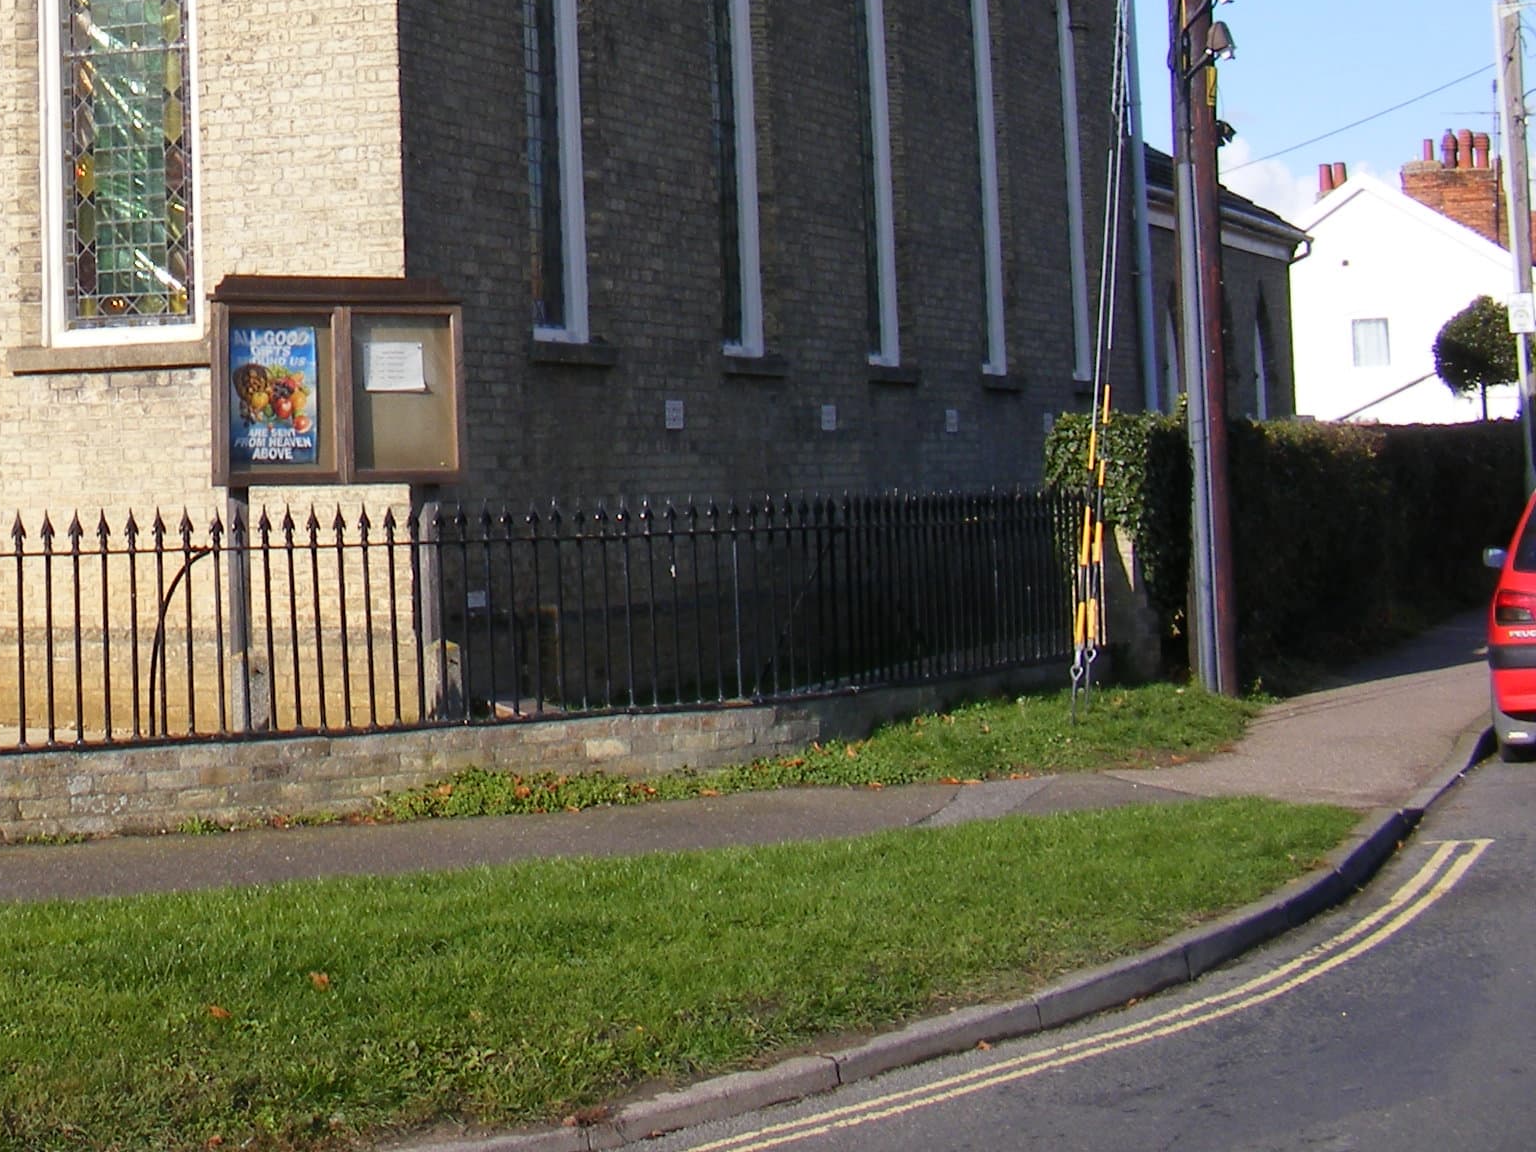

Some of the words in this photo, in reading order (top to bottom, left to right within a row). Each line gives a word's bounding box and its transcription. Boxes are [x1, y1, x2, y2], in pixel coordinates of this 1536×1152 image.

[234, 330, 260, 344] ALL
[263, 330, 310, 346] GOOD
[289, 356, 306, 366] US
[234, 437, 266, 447] FROM
[269, 436, 312, 447] HEAVEN
[252, 448, 293, 460] ABOVE
